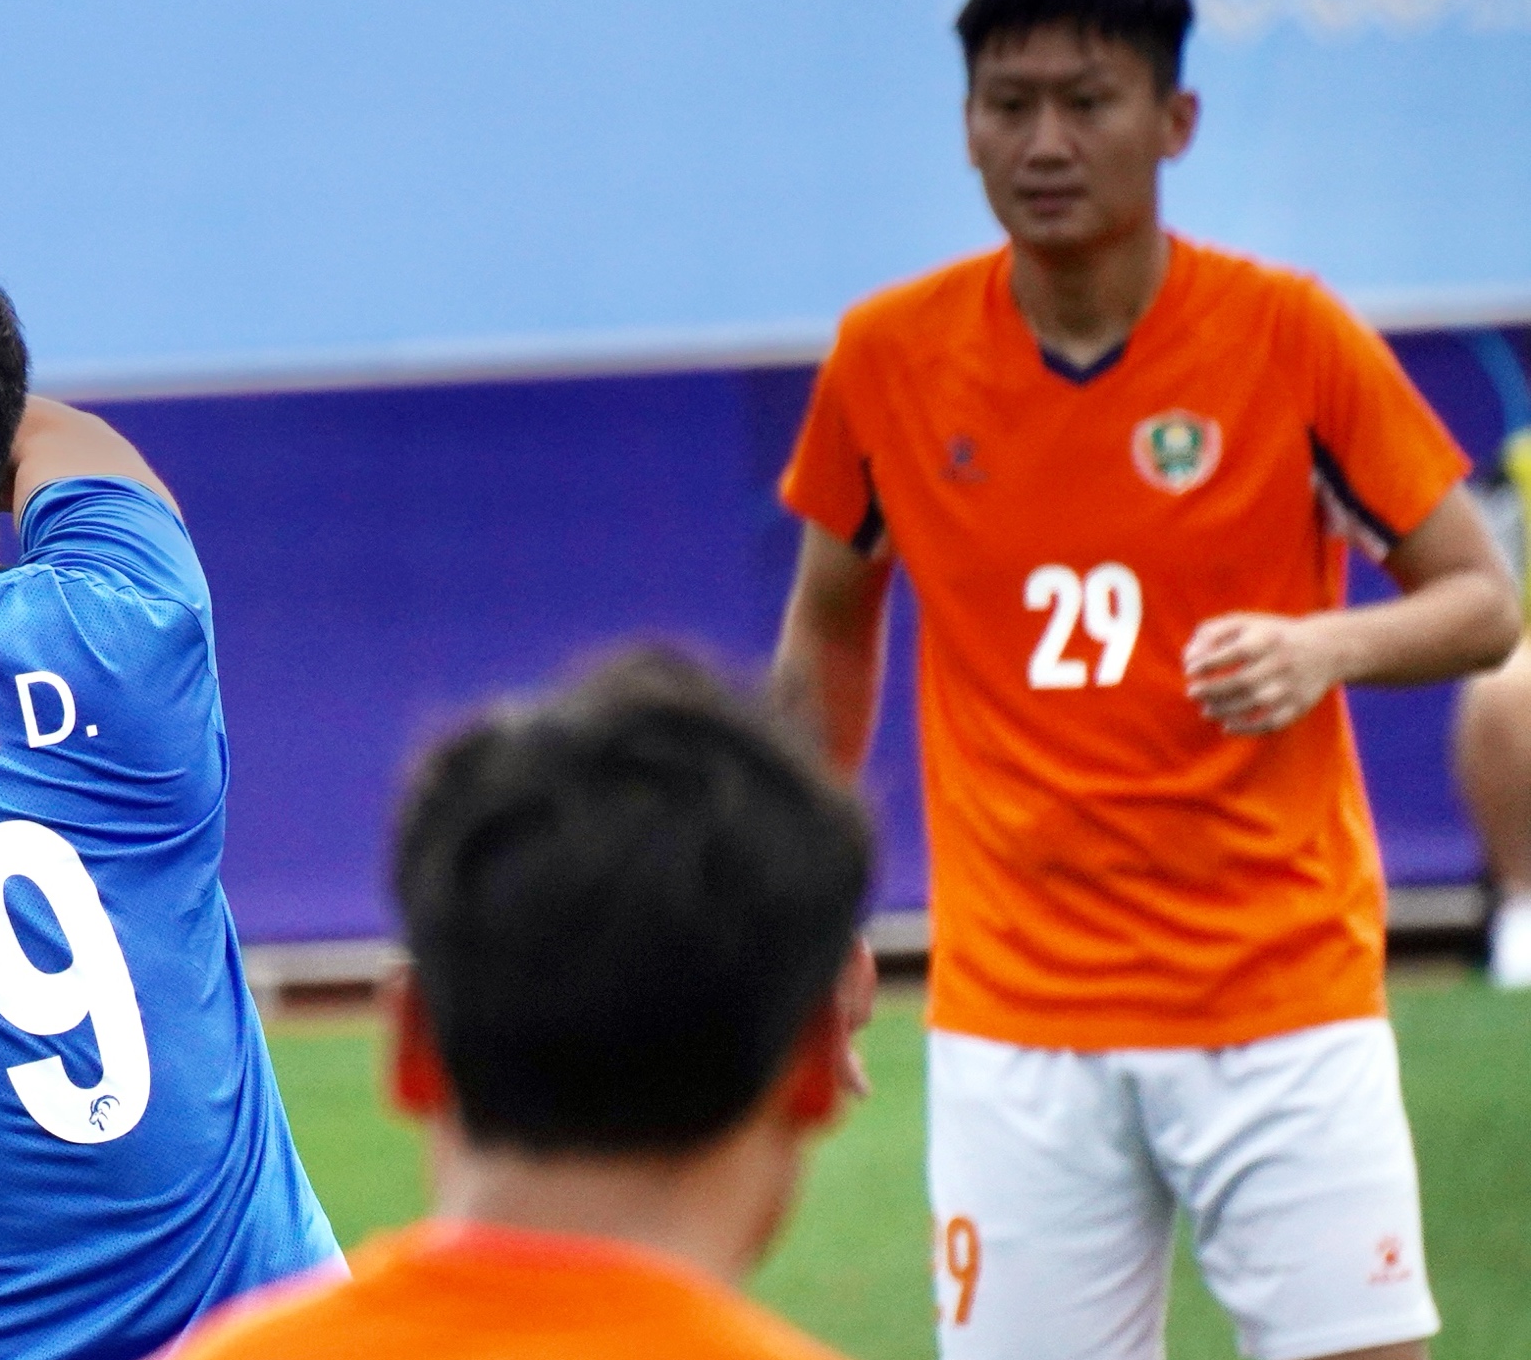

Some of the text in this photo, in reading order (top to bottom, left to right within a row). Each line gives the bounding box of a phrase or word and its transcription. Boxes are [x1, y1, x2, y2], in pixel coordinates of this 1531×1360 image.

[1024, 561, 1143, 691] 29
[19, 670, 98, 751] D.
[929, 1213, 981, 1327] 9
